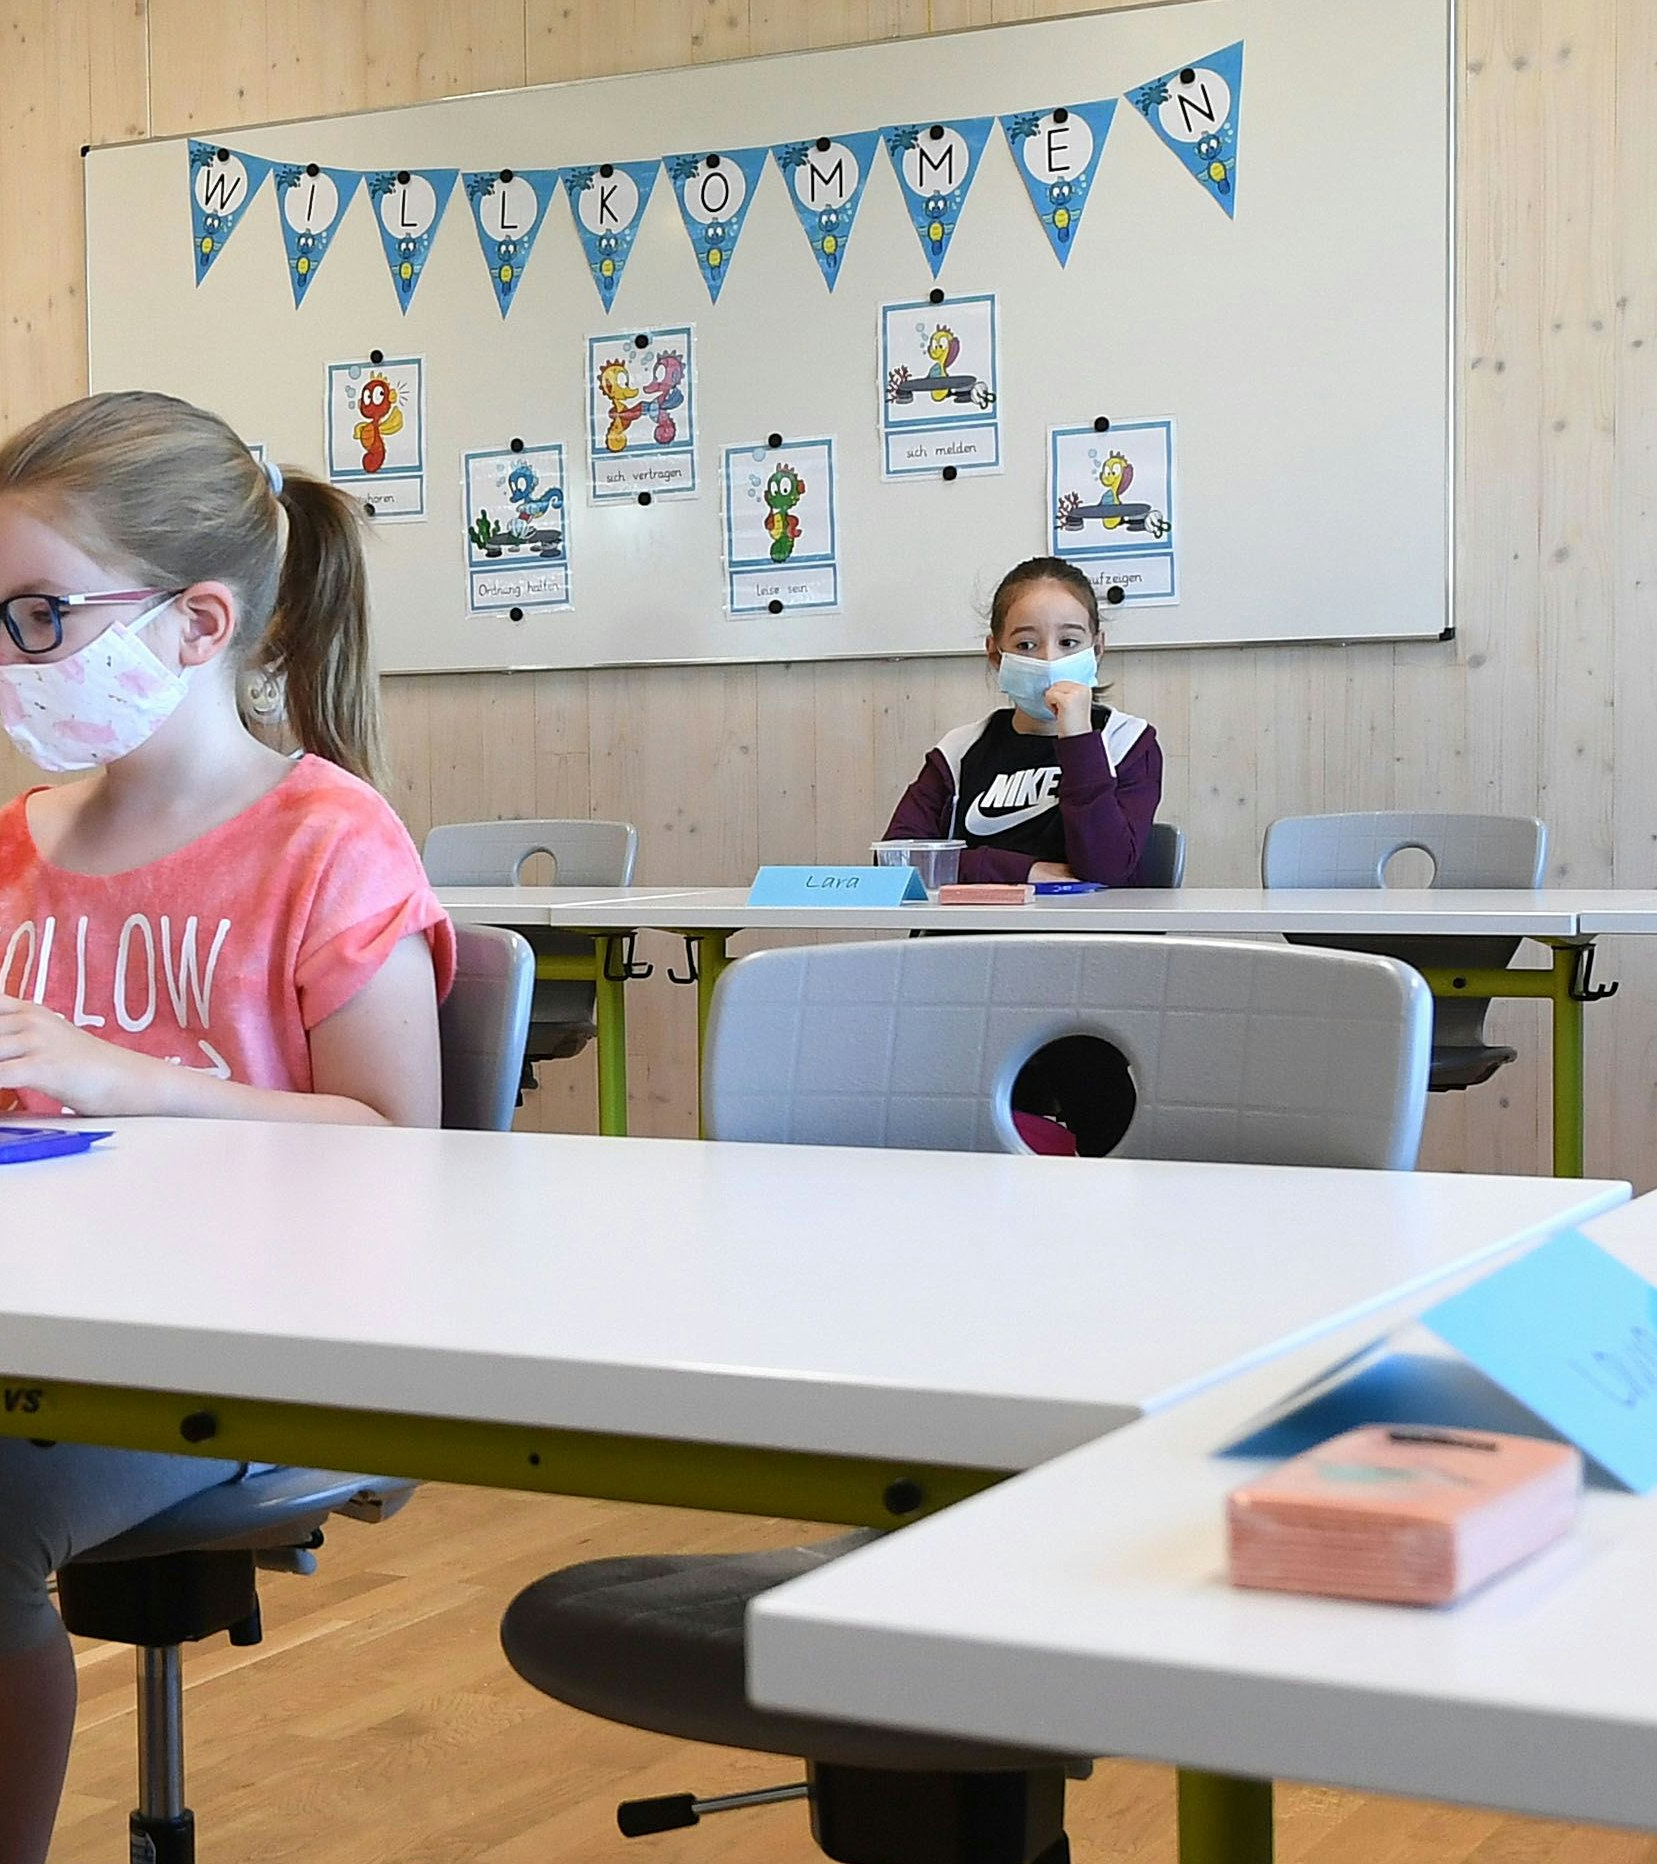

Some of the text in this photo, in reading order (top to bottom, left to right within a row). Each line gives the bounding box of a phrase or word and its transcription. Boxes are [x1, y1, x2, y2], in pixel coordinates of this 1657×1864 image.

[202, 82, 1216, 231] WILLKOMMEN
[906, 441, 977, 458] sich melden
[606, 468, 683, 483] sich vertragen
[1088, 571, 1143, 588] ufzeigen
[478, 583, 521, 598] Ordnung
[787, 584, 809, 594] sein
[979, 766, 1062, 808] NIKE
[806, 875, 860, 889] Lara
